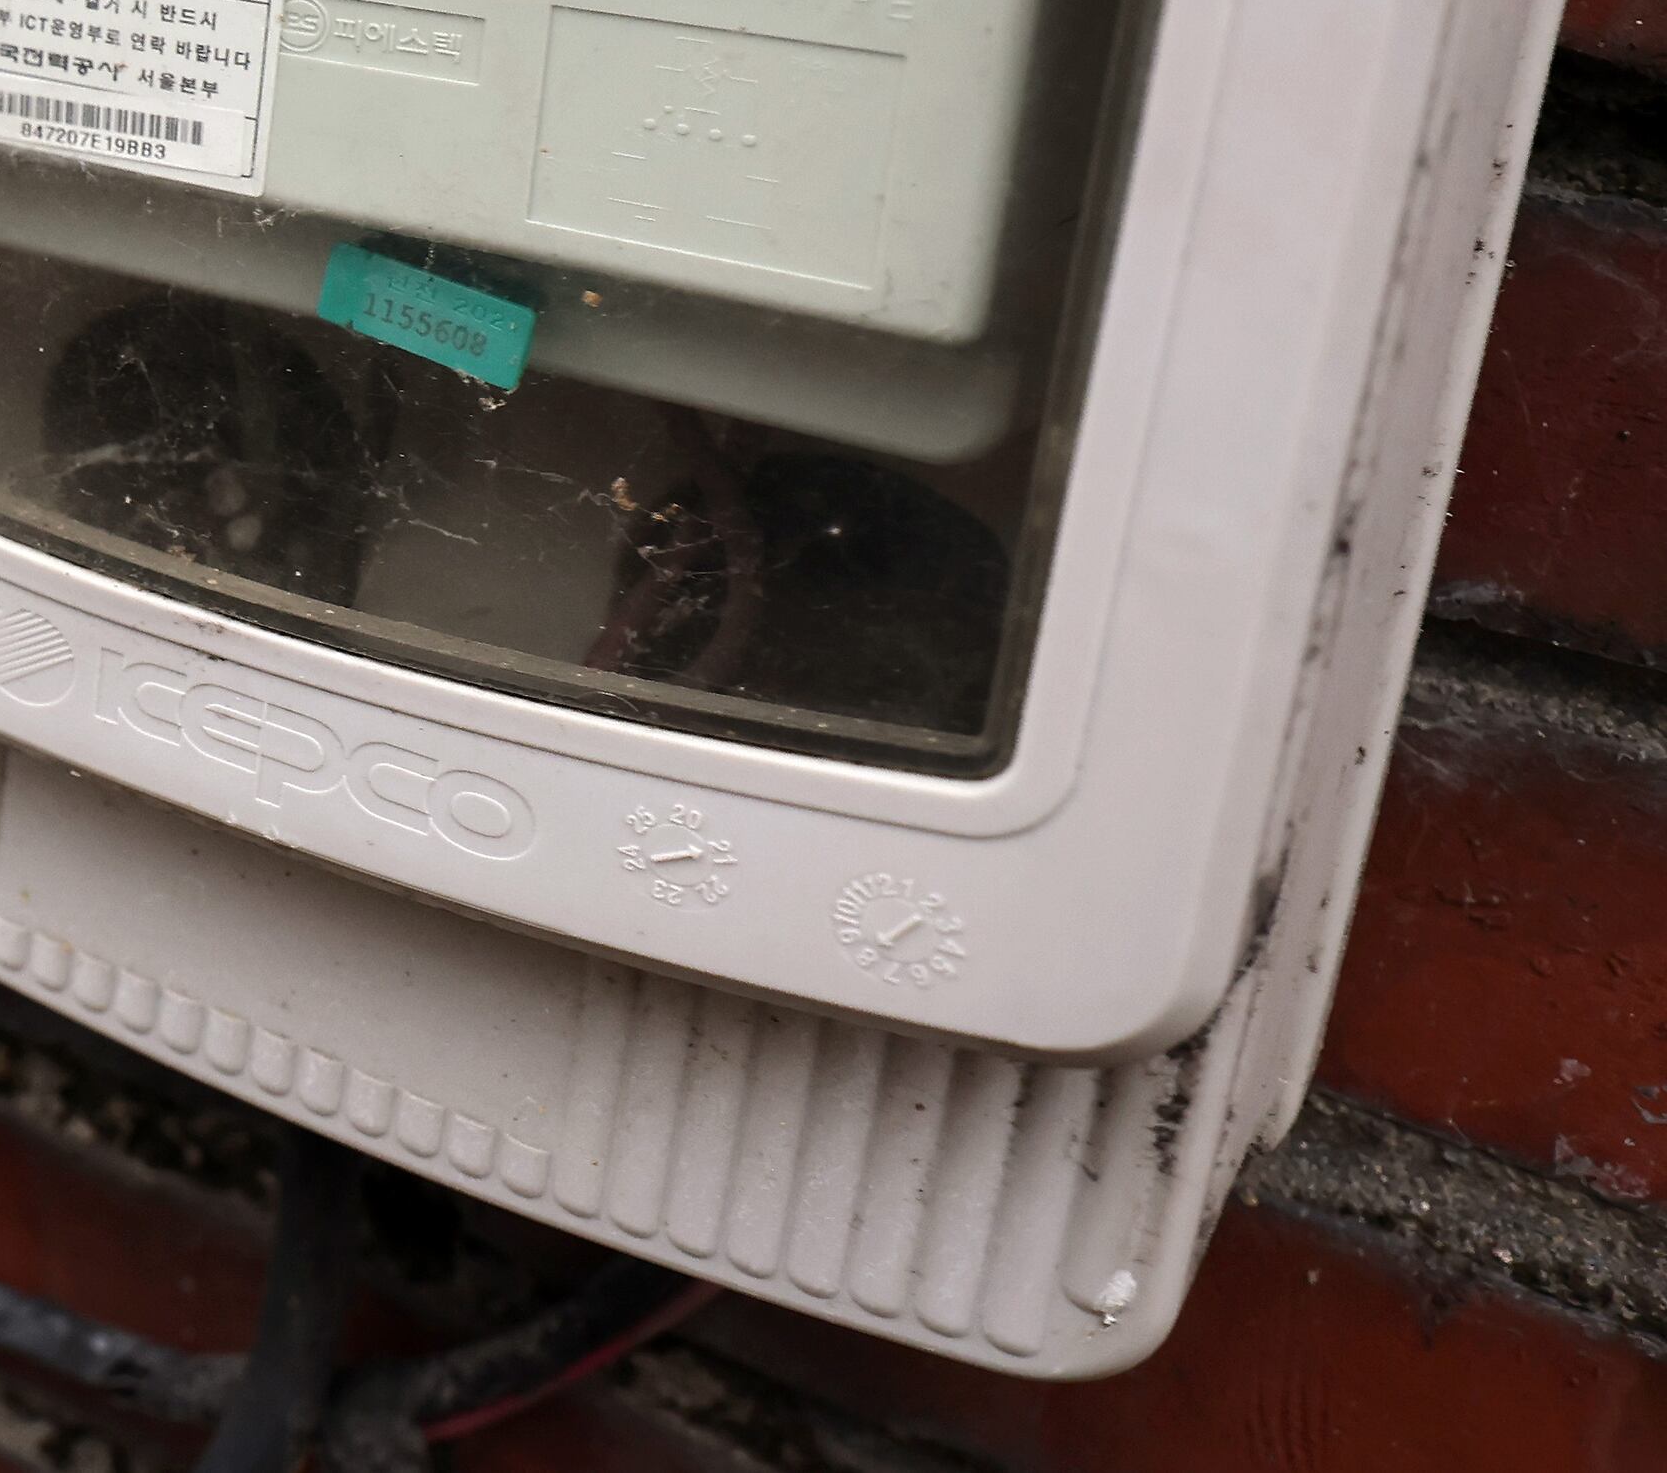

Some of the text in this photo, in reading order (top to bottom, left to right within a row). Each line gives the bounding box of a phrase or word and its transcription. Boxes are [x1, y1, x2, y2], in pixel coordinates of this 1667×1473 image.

[131, 0, 148, 19] 시
[160, 4, 218, 31] 반드시
[131, 31, 166, 56] 연락
[176, 40, 252, 71] 바랍니다
[333, 18, 463, 64] 피에스텍
[138, 69, 219, 100] 서울본부
[363, 292, 488, 357] 1155608
[92, 645, 536, 863] KEPCO
